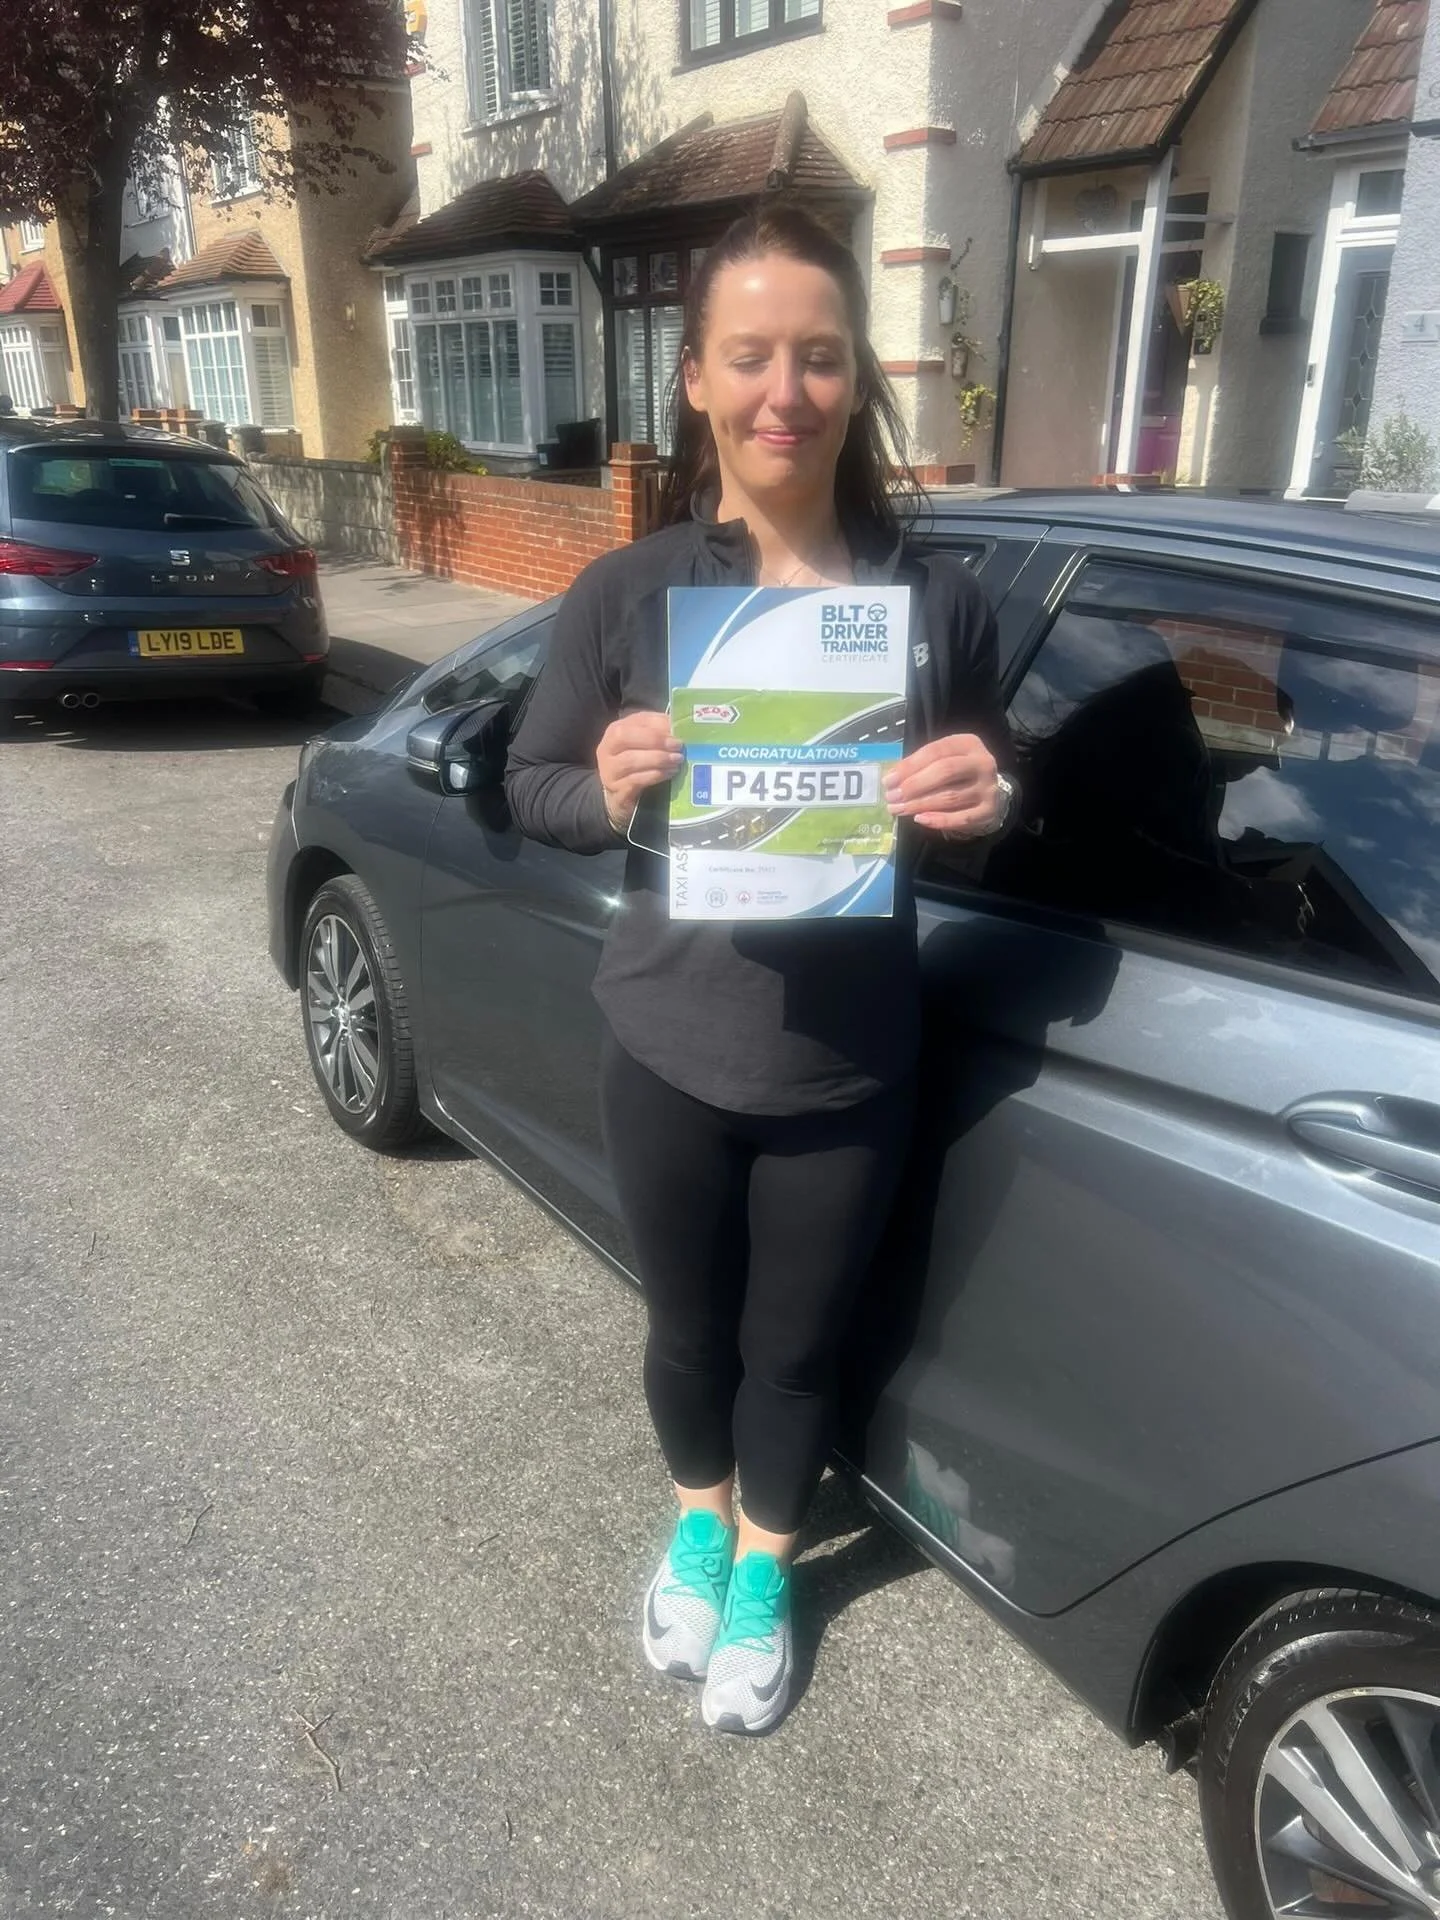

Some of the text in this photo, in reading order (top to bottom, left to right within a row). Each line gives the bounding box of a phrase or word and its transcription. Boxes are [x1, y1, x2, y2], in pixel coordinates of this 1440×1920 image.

[151, 575, 215, 583] LEON
[821, 604, 864, 623] BLT
[821, 623, 888, 640] DRIVER
[146, 631, 236, 652] LY19 LDE
[821, 640, 889, 653] TRAINING
[821, 653, 889, 664] CERTIFICATE
[718, 746, 859, 761] CONGRATULATIONS
[727, 769, 864, 802] P455ED
[675, 877, 689, 909] TAXI
